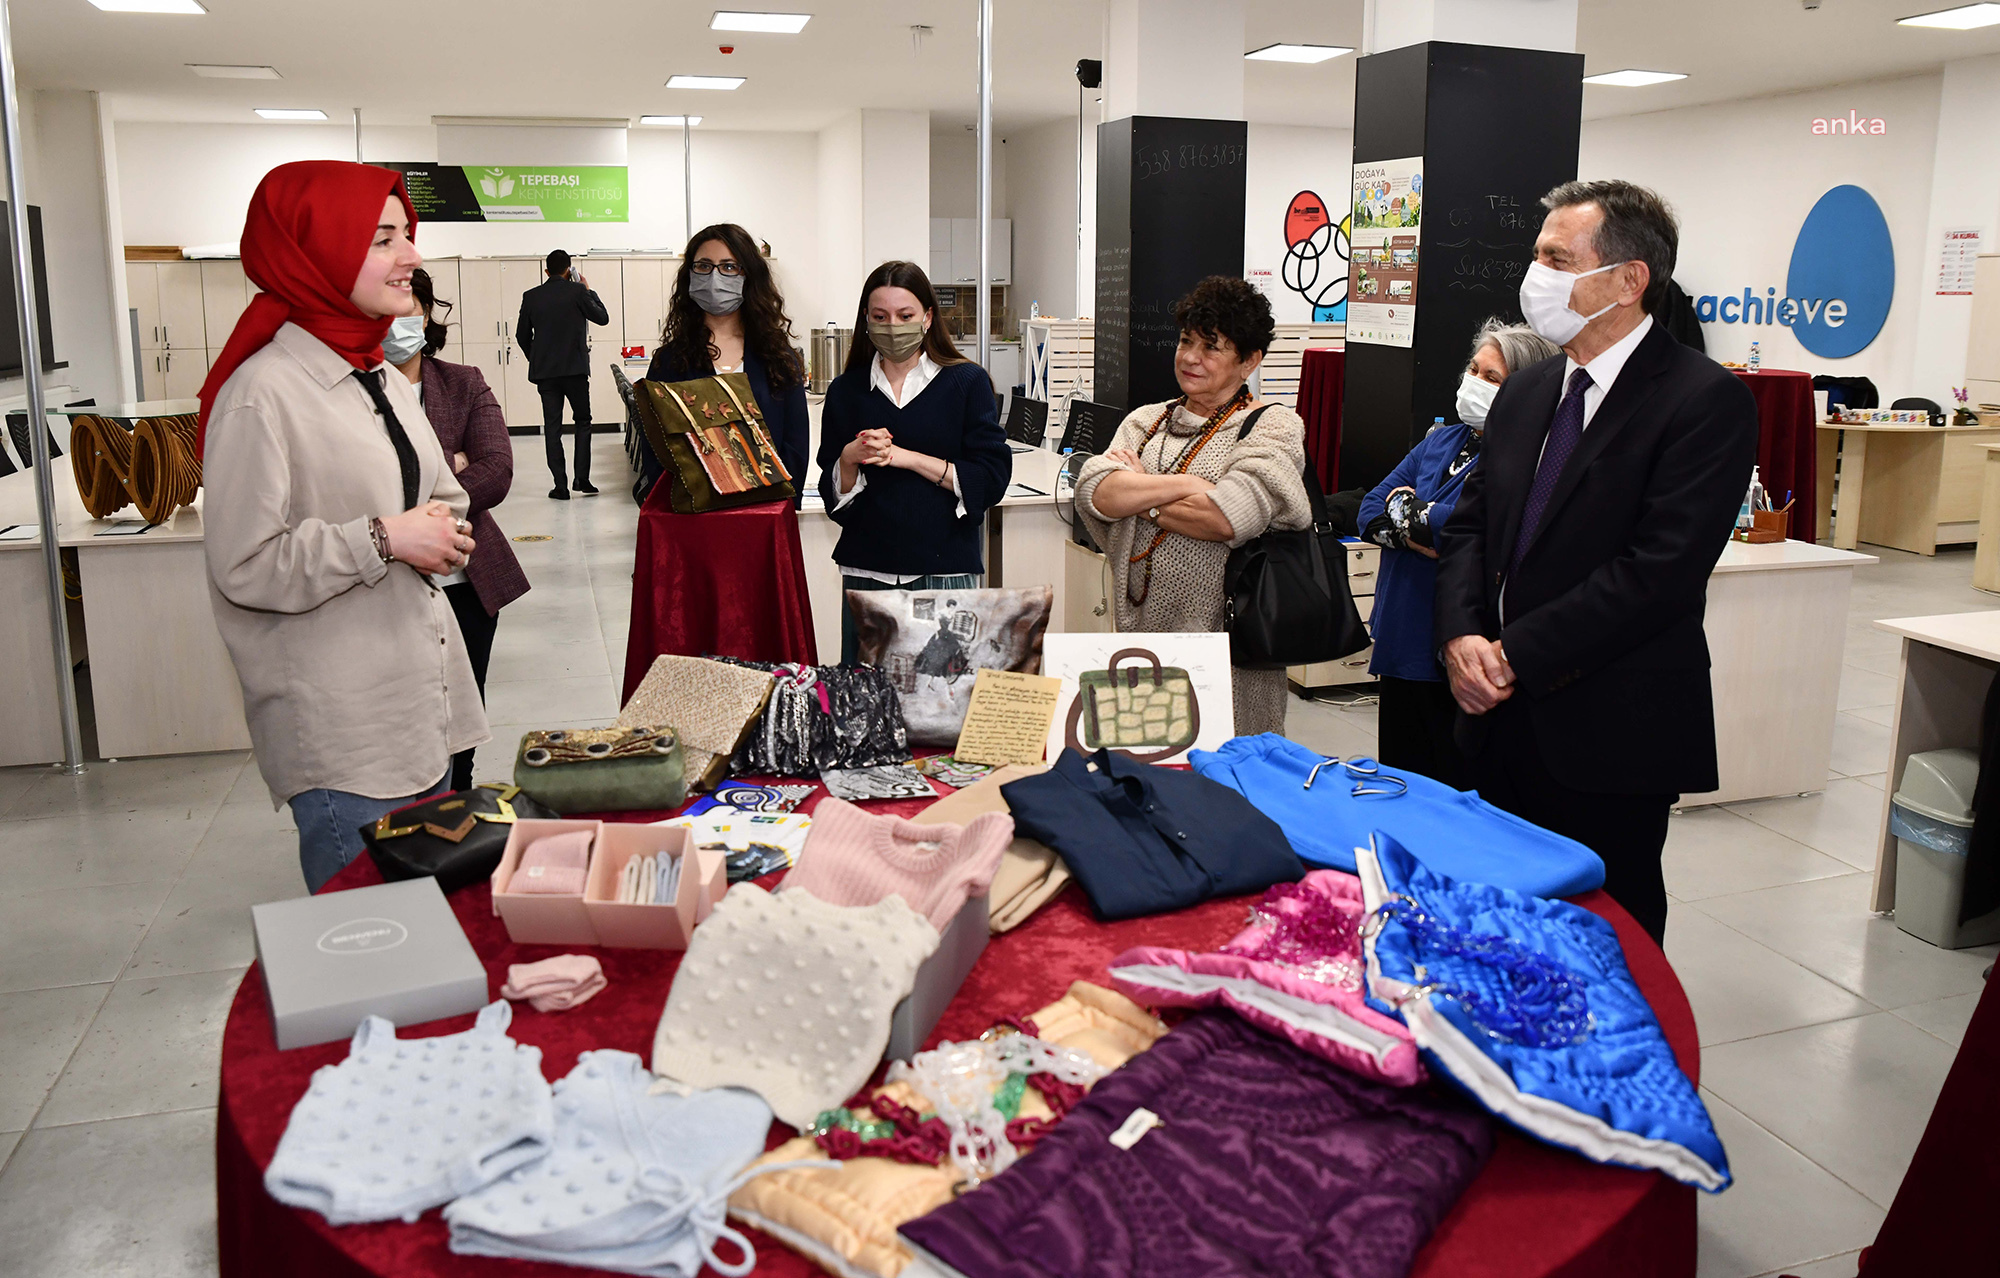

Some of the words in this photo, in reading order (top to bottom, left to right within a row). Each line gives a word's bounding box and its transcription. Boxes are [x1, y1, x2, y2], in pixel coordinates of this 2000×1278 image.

[519, 174, 580, 187] TEPEBAŞI
[1355, 168, 1386, 180] DOĞAYA
[519, 189, 551, 200] KENT
[556, 187, 623, 200] ENSTİTÜSÜ
[1485, 195, 1520, 210] TEL
[1696, 287, 1848, 328] achieve
